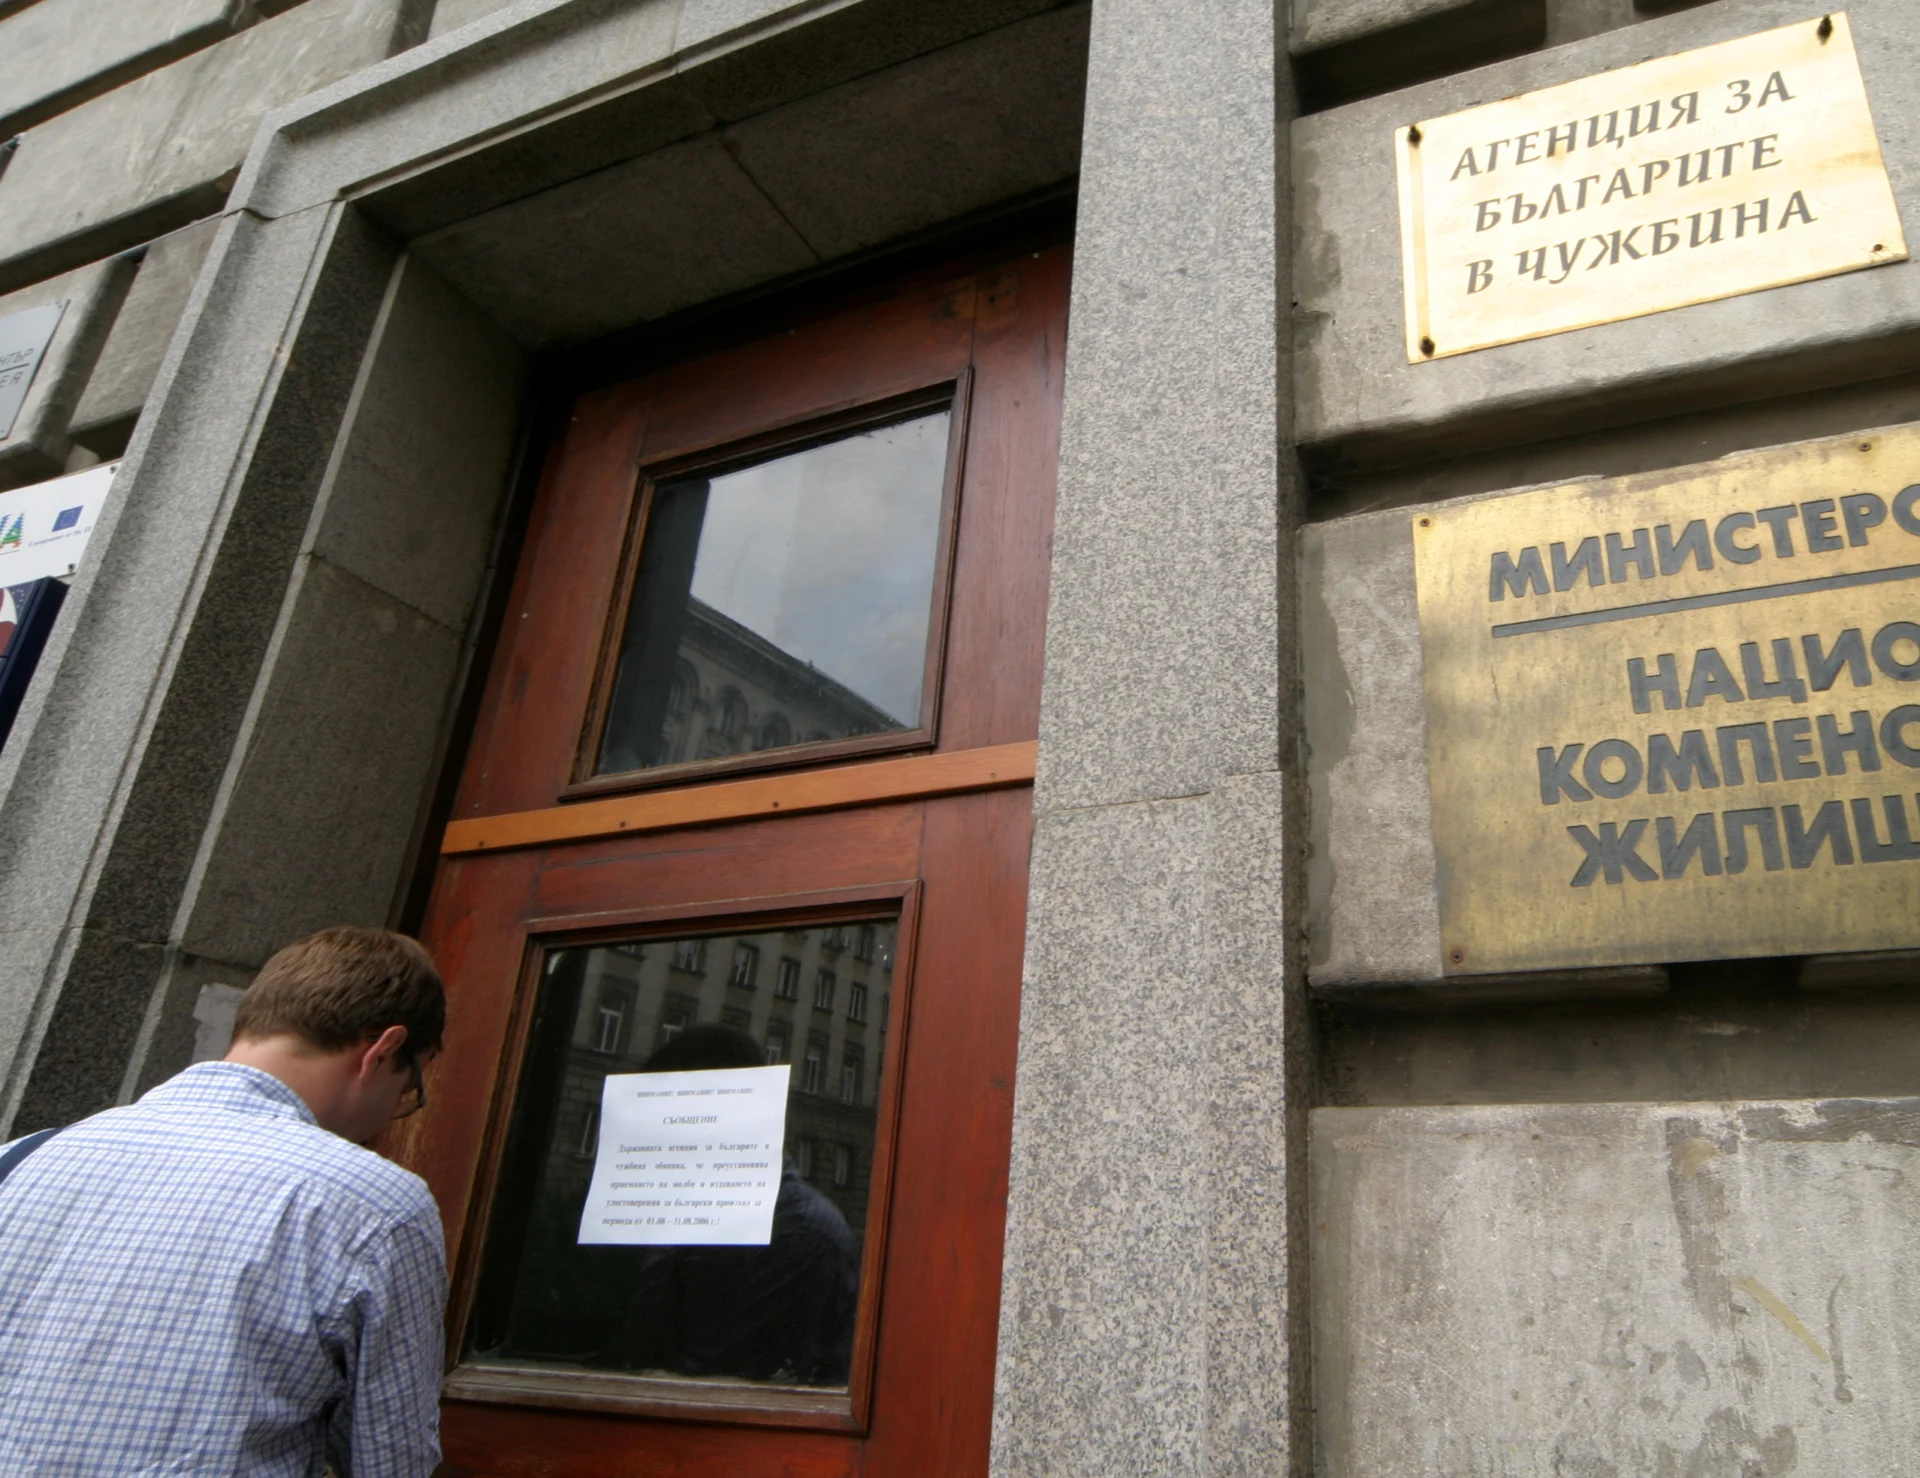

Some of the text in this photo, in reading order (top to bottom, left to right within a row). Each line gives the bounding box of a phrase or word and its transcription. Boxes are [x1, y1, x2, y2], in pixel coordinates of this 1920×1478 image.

[1449, 70, 1796, 181] АГЕНЦИЯ ЗА
[1474, 133, 1784, 233] БЪЛГАРИТЕ
[1465, 190, 1819, 295] В ЧУЖБИНА
[1626, 621, 1920, 715] НАЦИО
[662, 1115, 719, 1125] СЪОБЩЕНИЕ
[718, 1142, 758, 1153] българите
[615, 1161, 647, 1172] чужбина
[610, 1181, 655, 1191] приемането
[672, 1179, 695, 1188] молби
[605, 1199, 661, 1208] удостоверения
[674, 1197, 713, 1208] български
[602, 1217, 633, 1227] периода
[646, 1216, 666, 1225] 01.08
